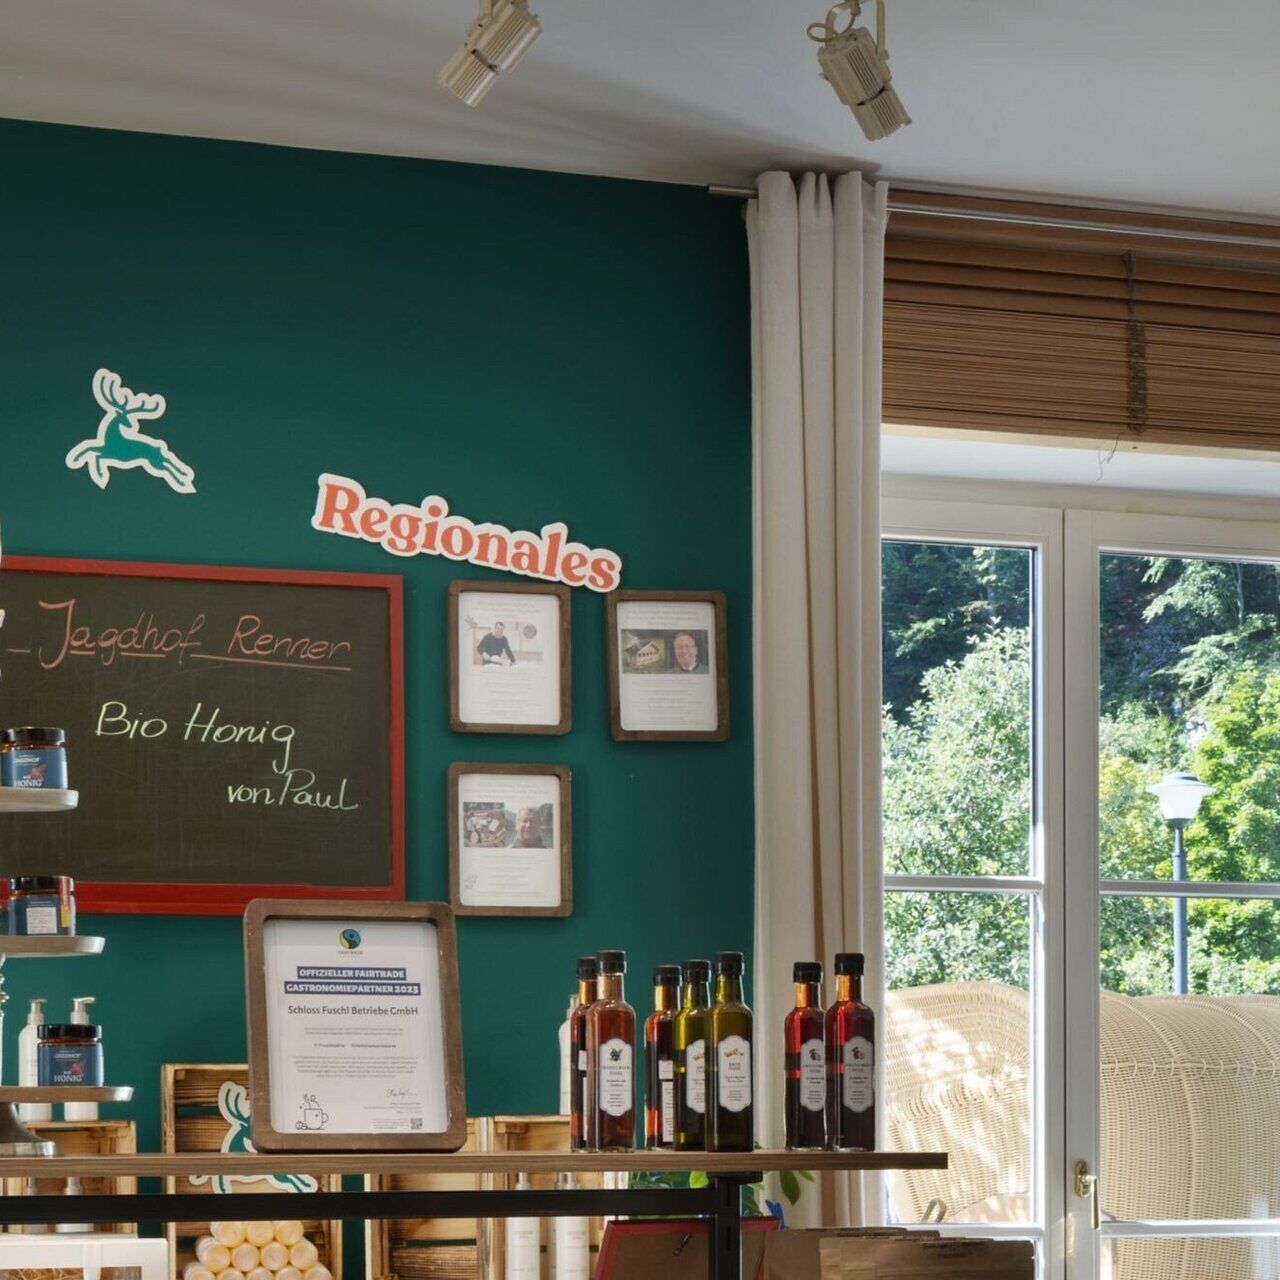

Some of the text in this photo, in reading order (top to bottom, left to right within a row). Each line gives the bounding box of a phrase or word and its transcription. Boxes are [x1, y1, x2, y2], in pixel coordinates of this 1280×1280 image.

[319, 480, 615, 590] Regionales
[38, 599, 352, 669] Jagdhof Renner
[95, 702, 296, 773] Bio Honig
[227, 771, 358, 811] von Paul
[298, 968, 405, 980] OFFIZIELLER FAIRTRADE
[286, 983, 420, 995] GASTRONOMIEPARTNER 2023
[288, 1005, 419, 1016] Schloss Fuschl Betriebe GmbH
[54, 1074, 82, 1082] HONIG
